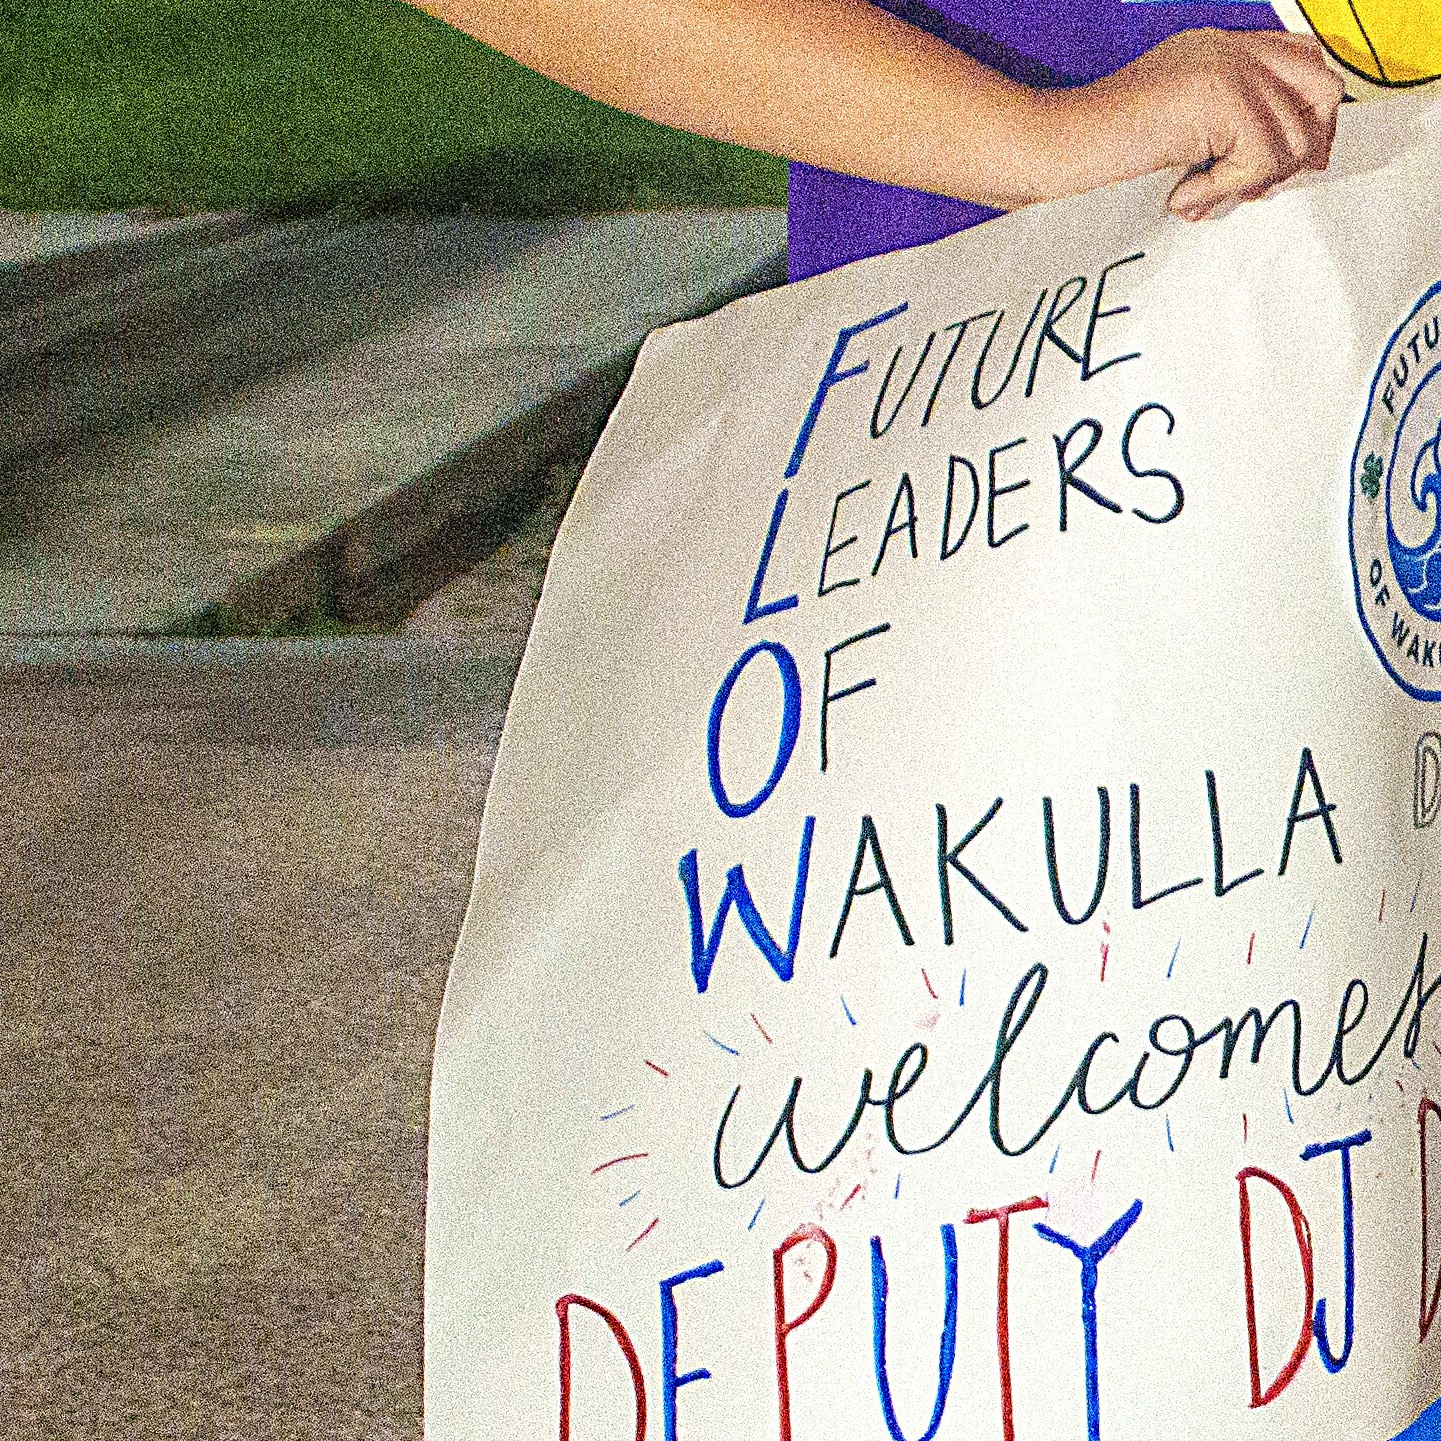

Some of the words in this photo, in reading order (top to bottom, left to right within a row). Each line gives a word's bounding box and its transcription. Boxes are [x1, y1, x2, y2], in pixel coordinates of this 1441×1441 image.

[782, 249, 1148, 478] FUTURE
[741, 401, 1188, 629] LEADERS
[1367, 556, 1391, 609] OF
[705, 623, 893, 819] OF
[679, 746, 1346, 994] WAKULLA
[1234, 1127, 1374, 1410] DJ
